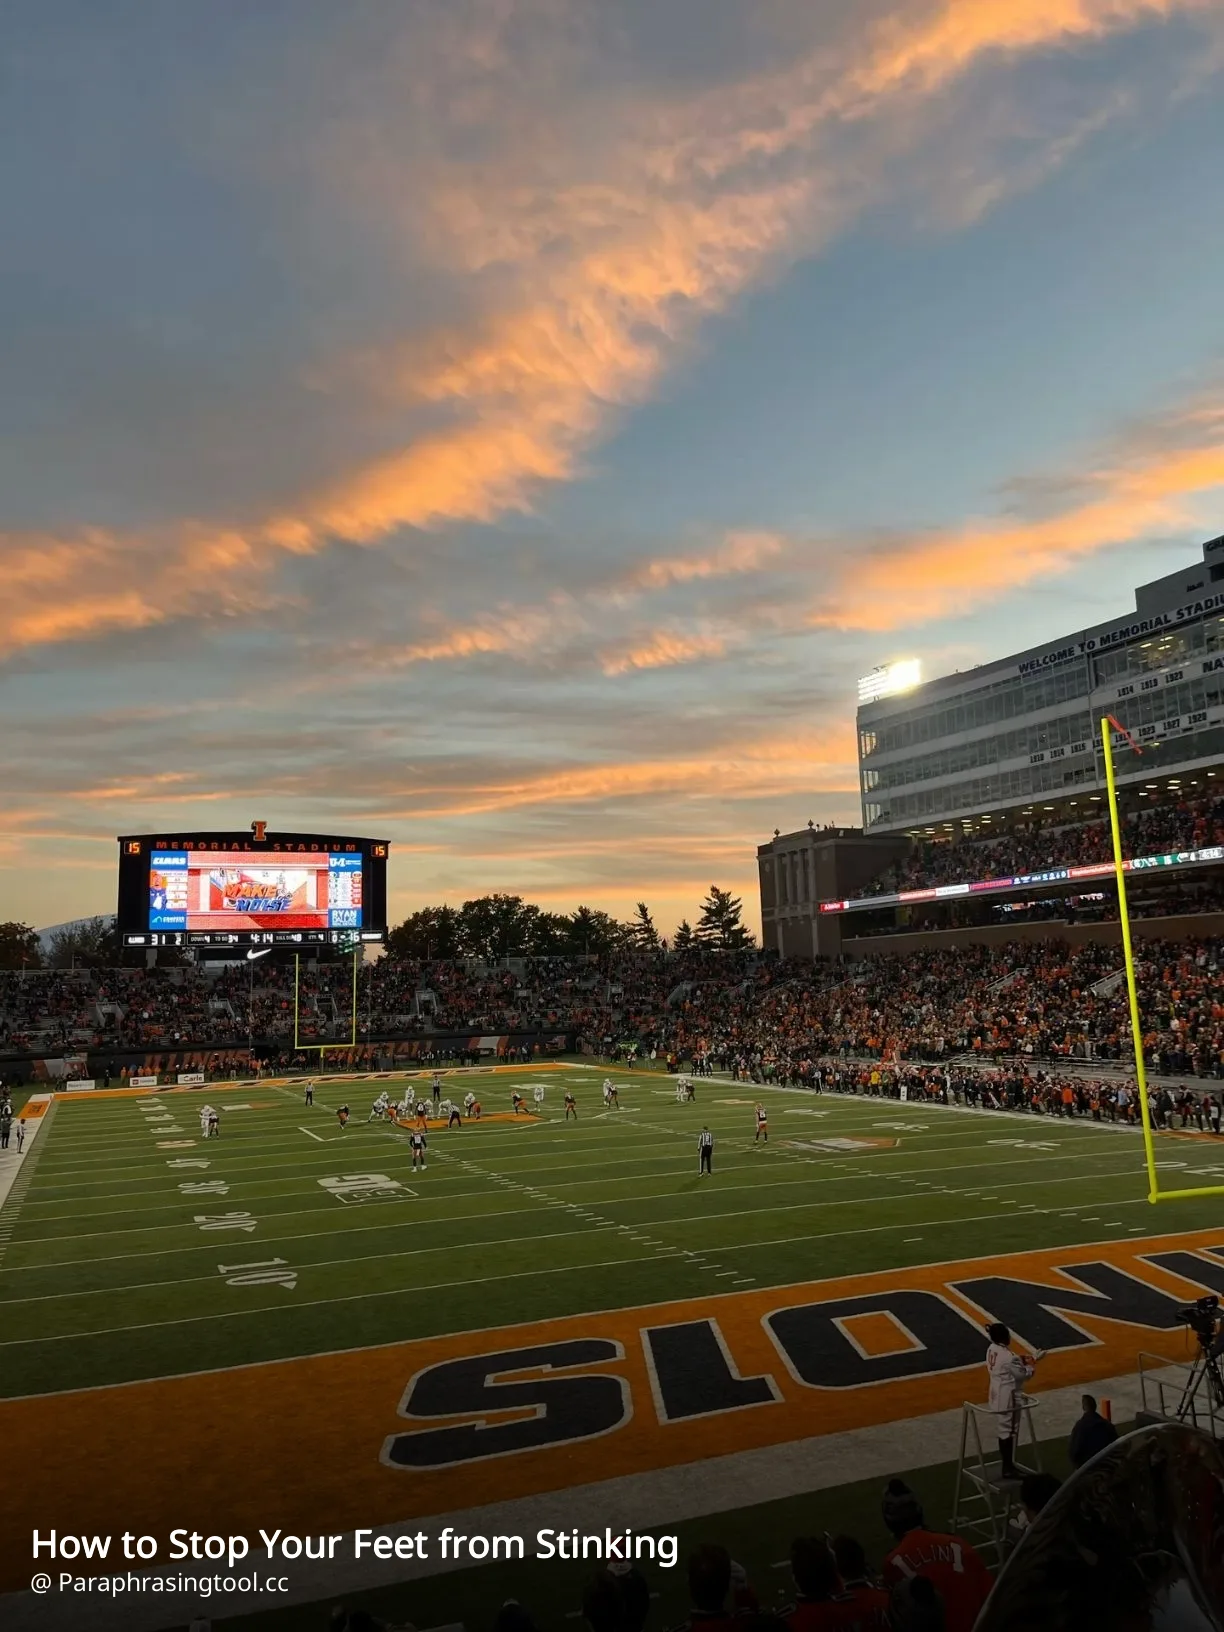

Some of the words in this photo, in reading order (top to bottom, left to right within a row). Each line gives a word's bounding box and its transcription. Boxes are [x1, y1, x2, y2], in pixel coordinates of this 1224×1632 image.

[1018, 646, 1075, 673] WELCOME
[1078, 640, 1095, 652] TO
[1100, 614, 1172, 646] MEMORIAL
[1203, 657, 1224, 673] NA
[128, 842, 140, 854] 15
[155, 841, 251, 850] MEMORIAL
[273, 843, 356, 852] STADIUM
[375, 846, 385, 856] 15
[222, 884, 278, 898] MAKE
[235, 897, 292, 911] NOISE
[250, 933, 273, 943] 4:14
